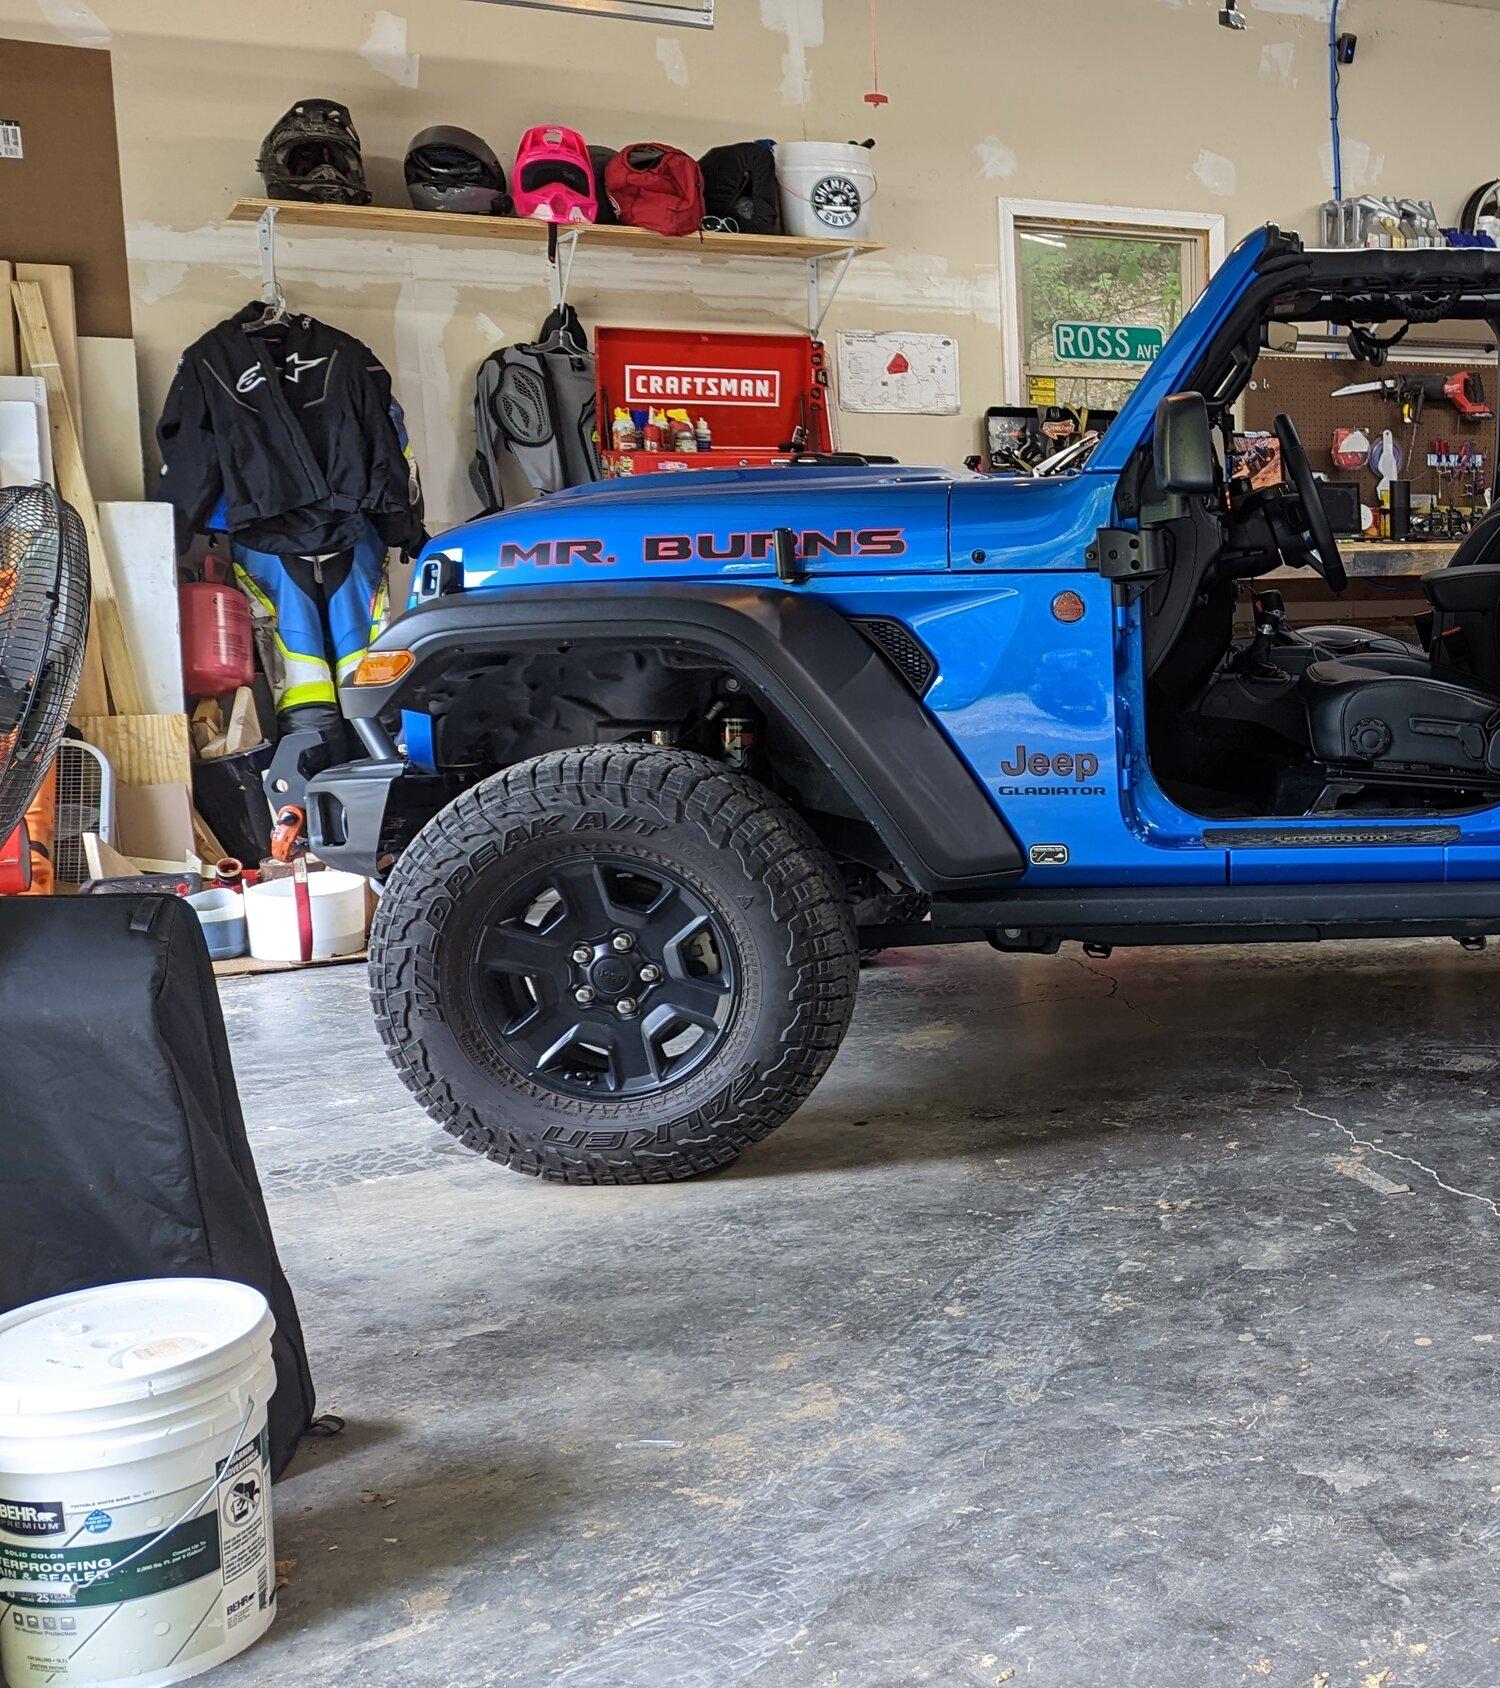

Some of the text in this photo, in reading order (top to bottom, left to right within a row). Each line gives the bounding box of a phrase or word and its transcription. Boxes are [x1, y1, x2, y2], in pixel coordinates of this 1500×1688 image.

[824, 211, 852, 224] GUYS
[1057, 325, 1131, 358] ROSS
[635, 374, 771, 398] CRAFTSMAN
[500, 528, 907, 568] MR. BURNS
[1000, 745, 1099, 782] Jeep
[998, 786, 1107, 796] GLADIATOR
[0, 1503, 38, 1522] BEHR
[5, 1548, 64, 1560] SOLID COLOR
[37, 1593, 50, 1603] 25
[226, 1595, 250, 1616] BEHR
